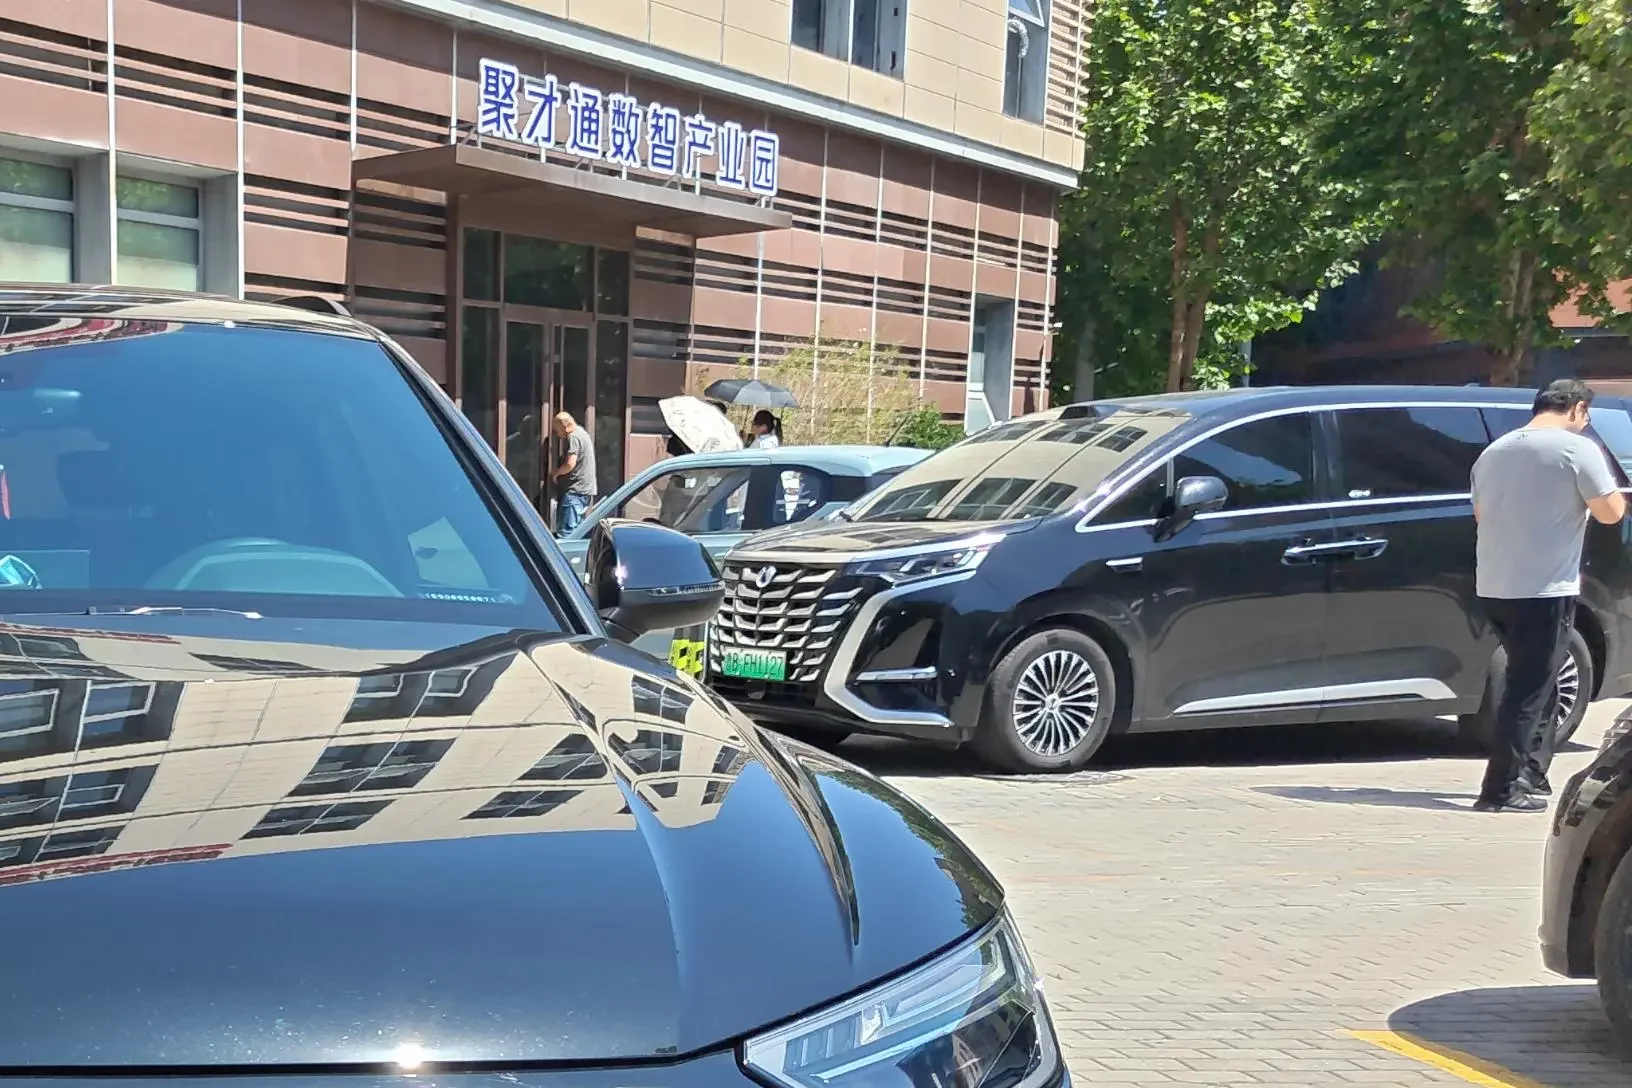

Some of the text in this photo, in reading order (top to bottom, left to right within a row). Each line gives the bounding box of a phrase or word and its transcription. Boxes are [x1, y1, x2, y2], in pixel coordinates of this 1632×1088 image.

[479, 58, 779, 195] 聚才通数智产业园
